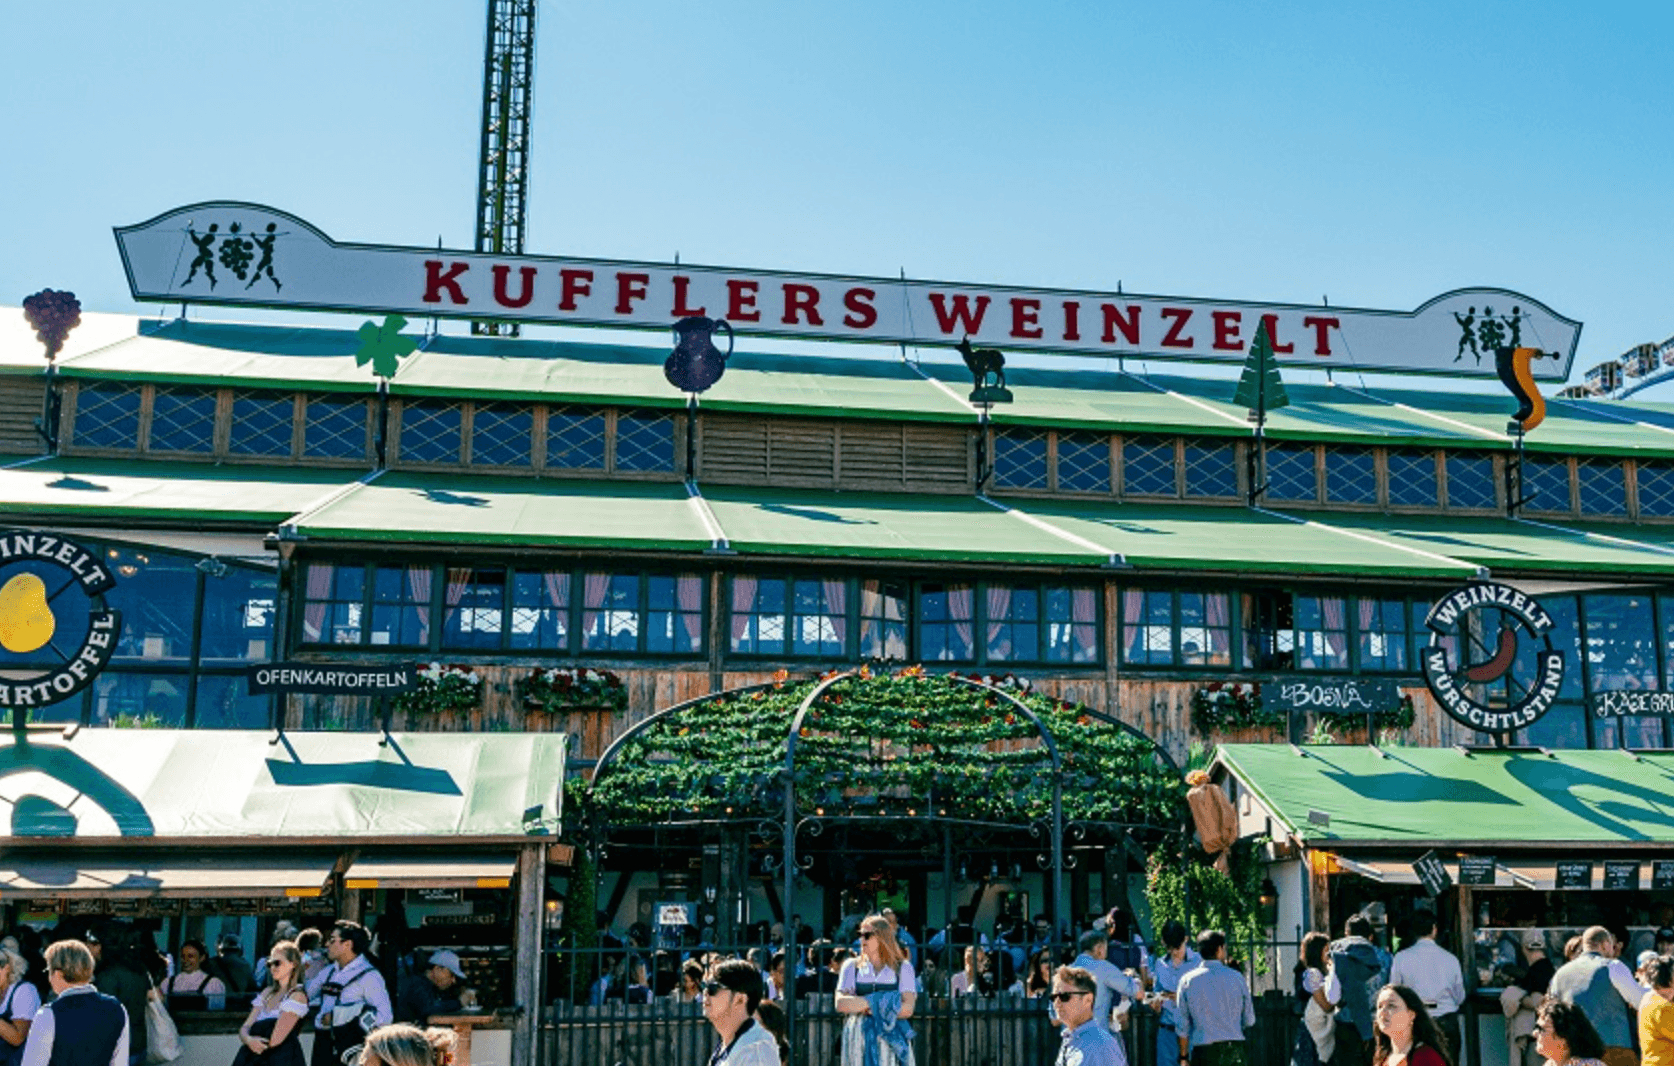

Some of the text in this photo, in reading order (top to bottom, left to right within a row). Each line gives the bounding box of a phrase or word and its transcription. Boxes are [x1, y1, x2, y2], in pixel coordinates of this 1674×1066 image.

[422, 259, 1340, 356] KUFFLERS WEINZELT
[1435, 585, 1552, 629] WEINZELT
[256, 669, 408, 688] OFENKARTOFFELN
[1428, 651, 1563, 729] WÜRSCHTLSTAND
